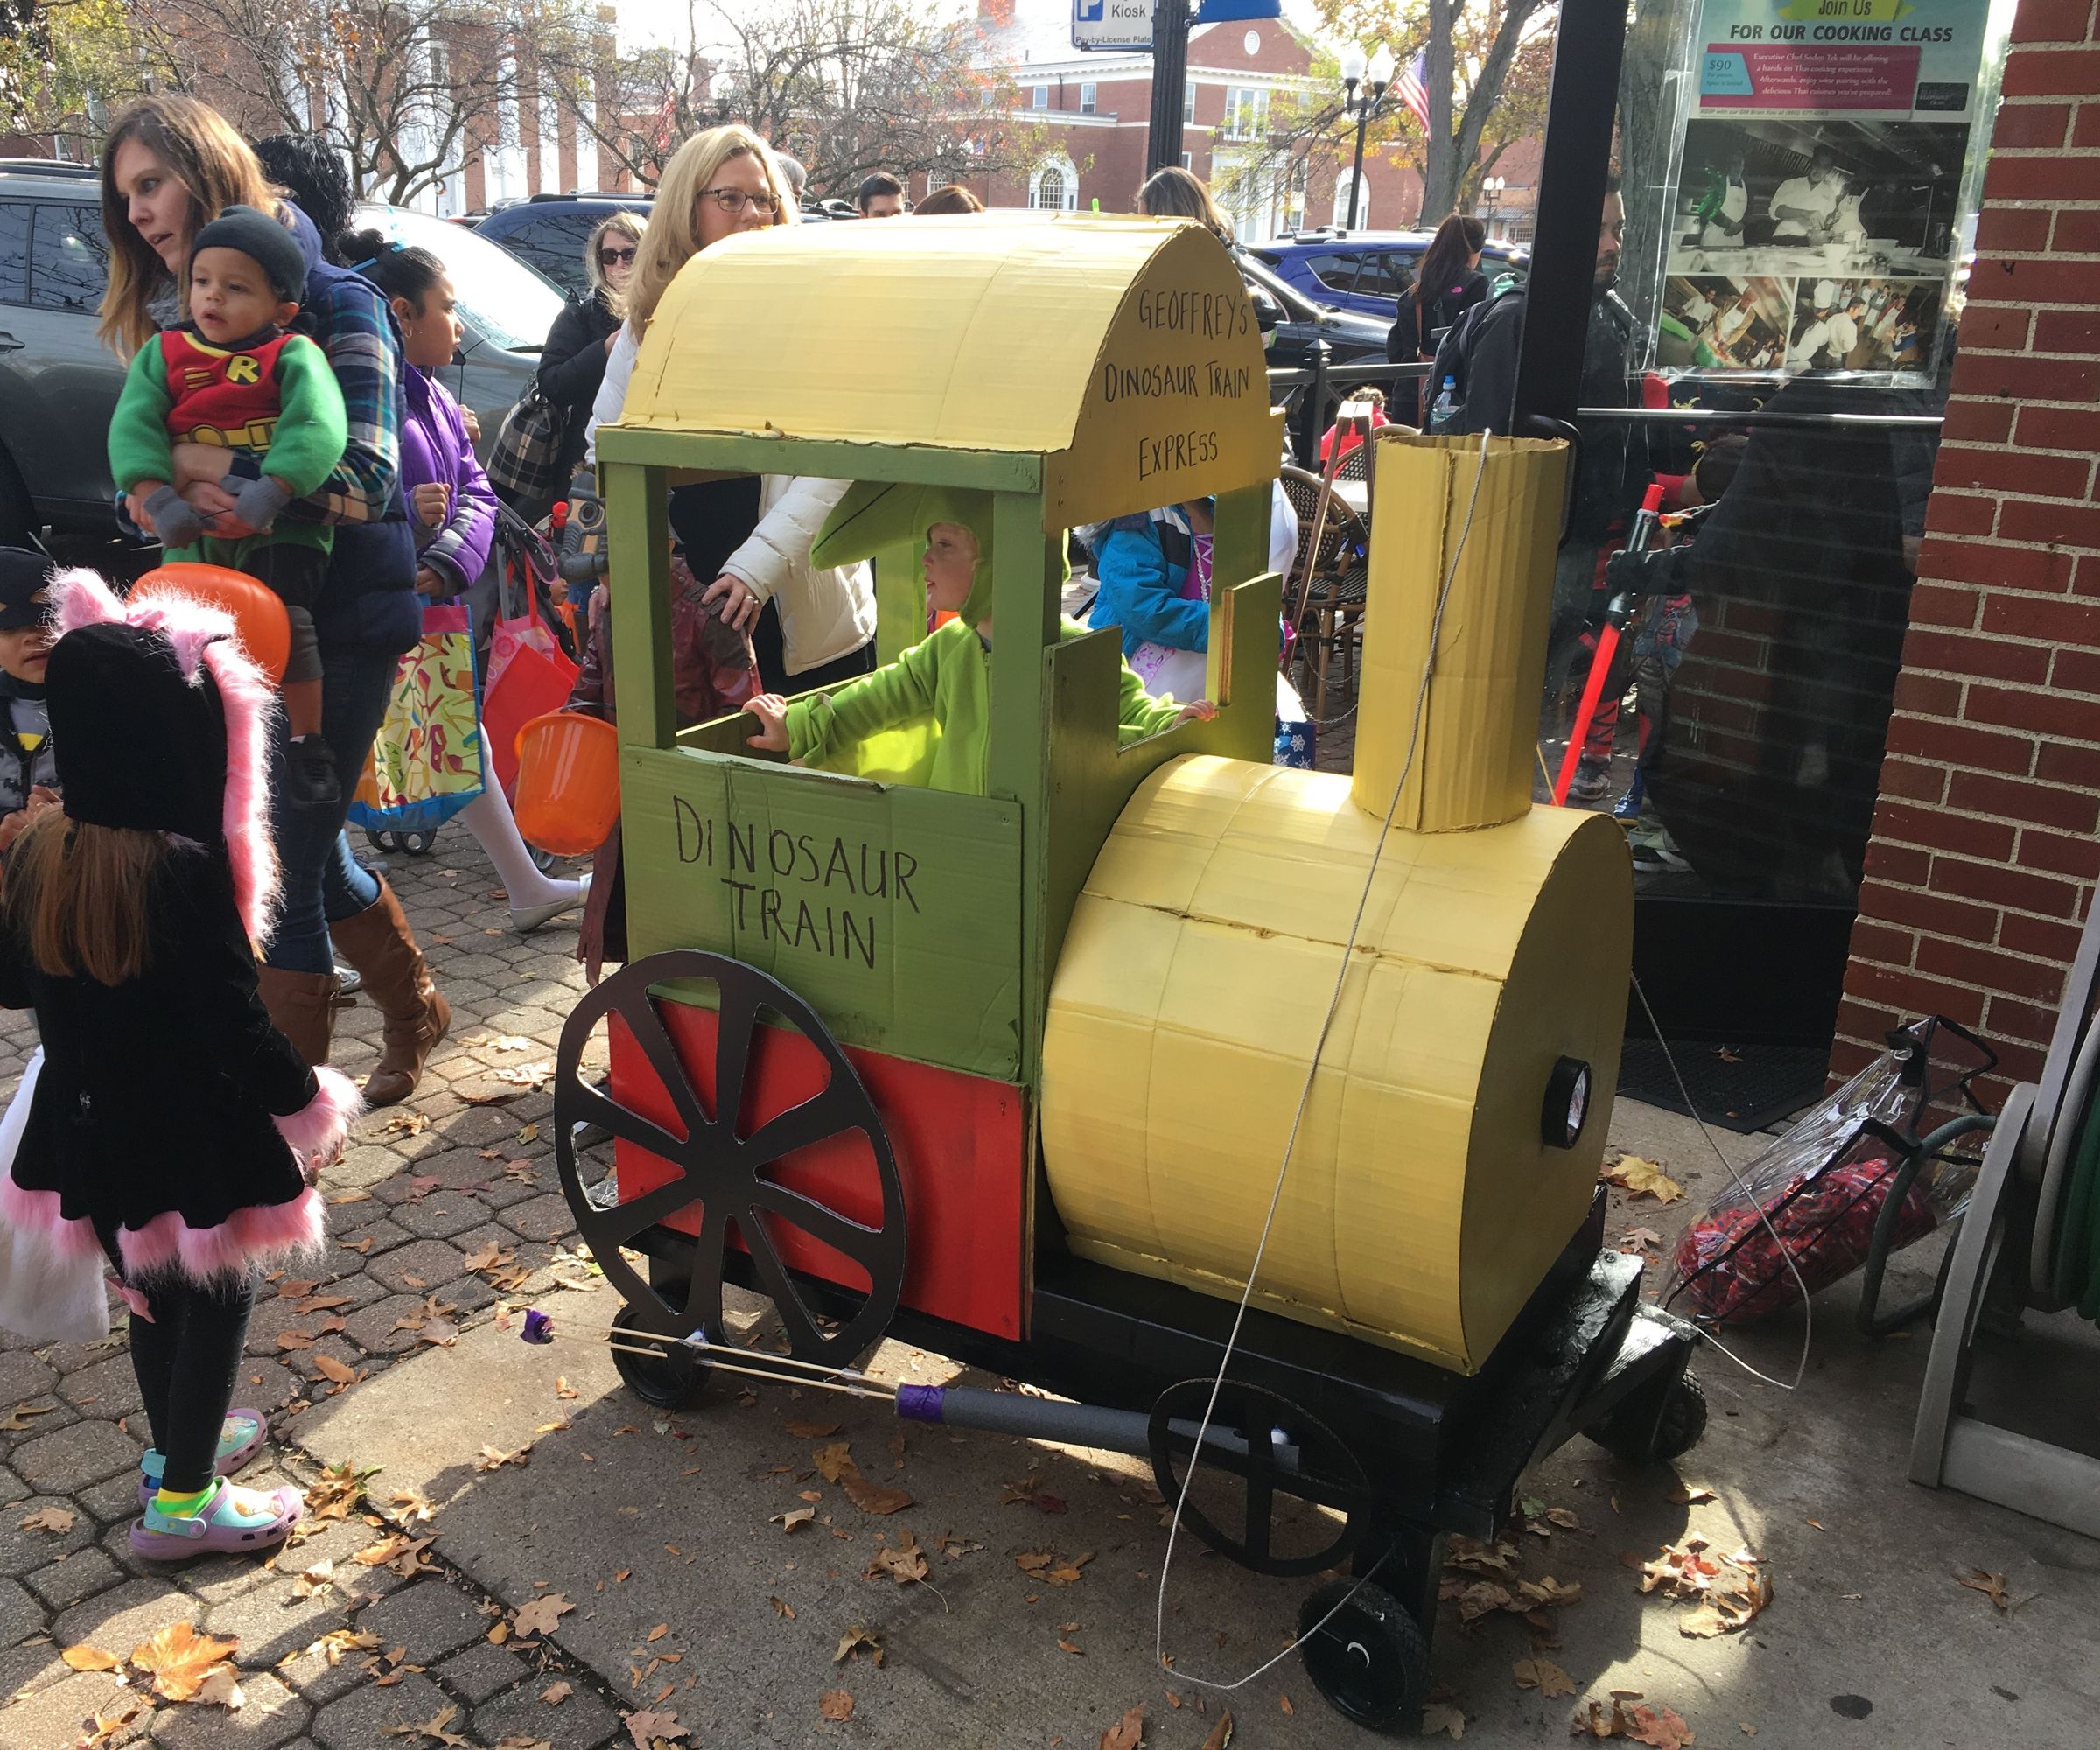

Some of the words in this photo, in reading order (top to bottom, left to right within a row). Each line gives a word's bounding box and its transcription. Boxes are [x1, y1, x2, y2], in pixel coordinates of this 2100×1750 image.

[1111, 4, 1146, 18] Kiosk
[1818, 0, 1849, 15] Join
[1852, 0, 1872, 15] Us
[1729, 24, 1763, 39] FOR
[1770, 24, 1806, 40] OUR
[1812, 24, 1893, 42] COOKING
[1899, 26, 1953, 43] CLASS
[1709, 60, 1732, 71] $90
[1810, 65, 1837, 74] cooking
[1799, 76, 1816, 85] enjoy
[225, 355, 260, 383] R
[1104, 363, 1199, 402] DINOSAUR
[1205, 360, 1250, 399] TRAIN
[1139, 431, 1218, 481] EXPRESS
[673, 794, 920, 914] DINOSAUR
[720, 878, 874, 969] TRAIN
